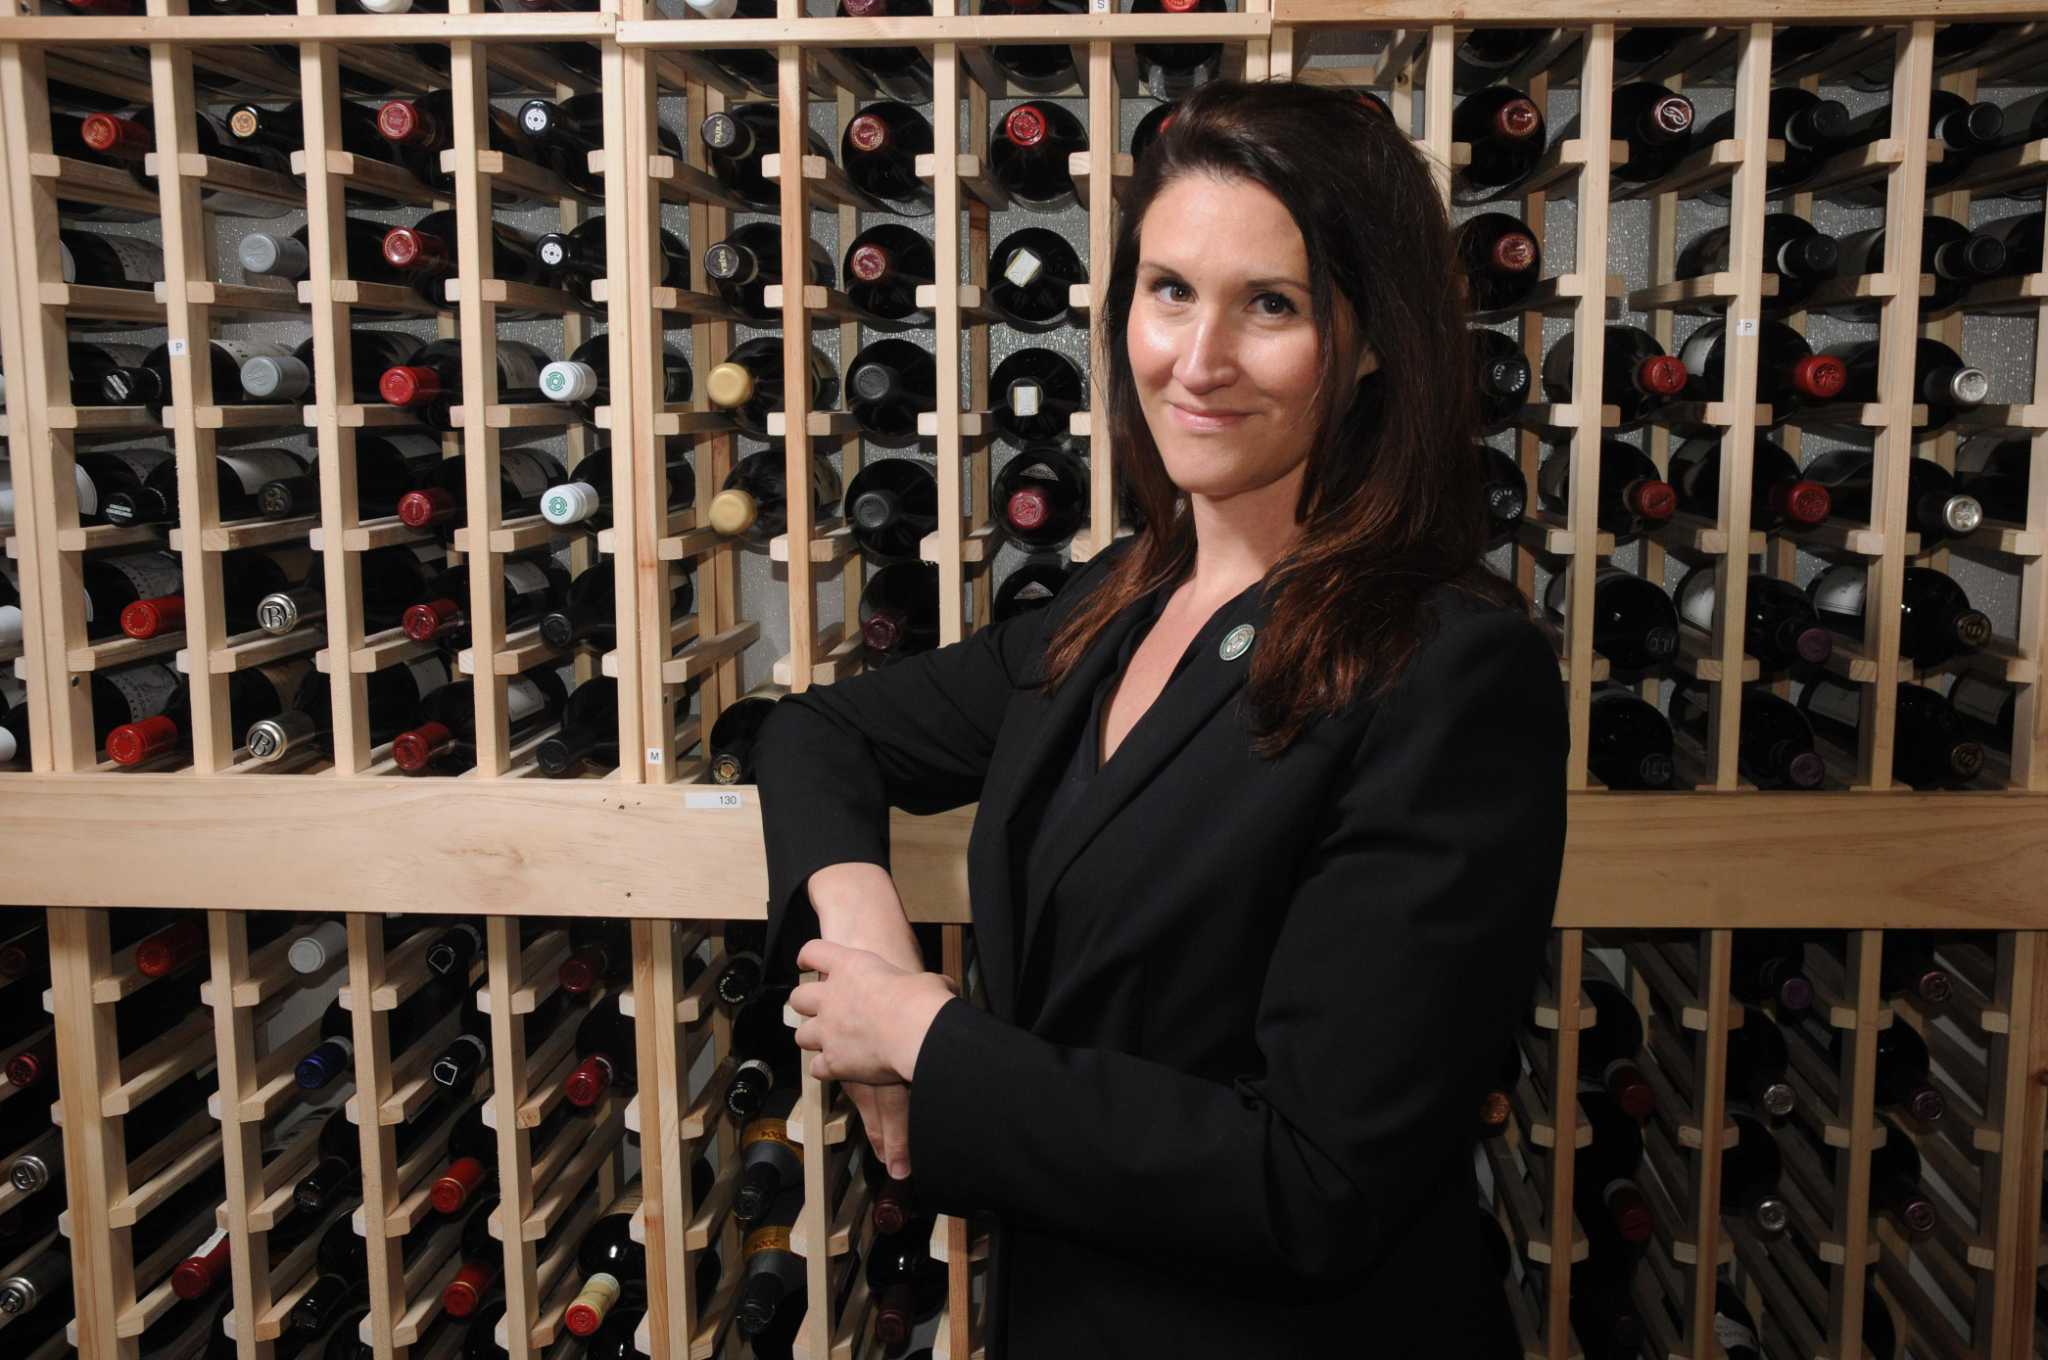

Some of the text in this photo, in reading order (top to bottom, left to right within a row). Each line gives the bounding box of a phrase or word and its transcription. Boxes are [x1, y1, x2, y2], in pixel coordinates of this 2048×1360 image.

[1744, 322, 1752, 331] P
[175, 342, 182, 352] P
[650, 752, 659, 760] M
[719, 796, 737, 805] 130
